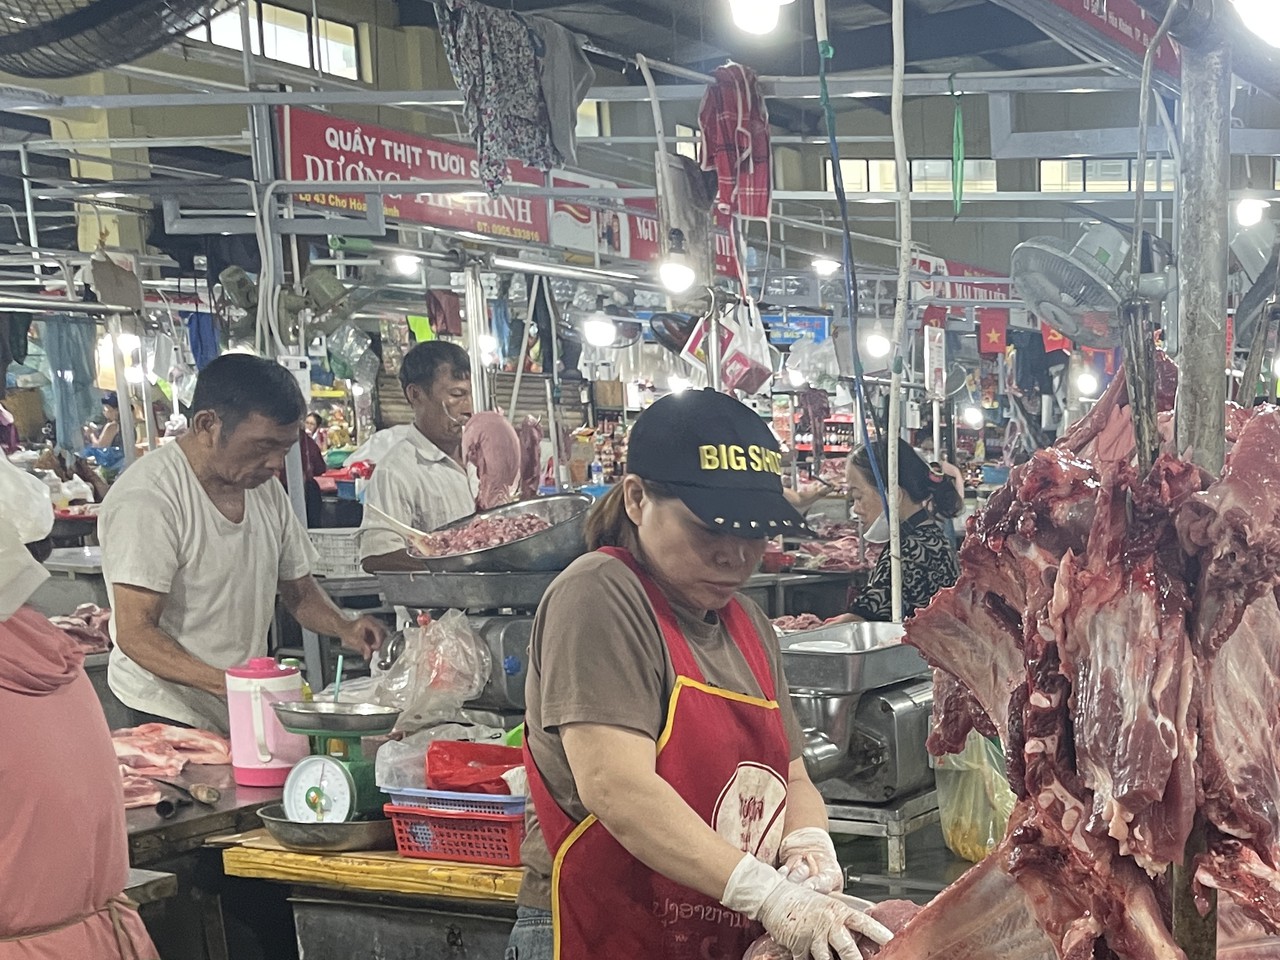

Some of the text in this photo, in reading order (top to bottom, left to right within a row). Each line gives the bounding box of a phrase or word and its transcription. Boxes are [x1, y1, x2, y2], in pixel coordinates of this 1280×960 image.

[325, 126, 376, 157] QUẦY
[381, 139, 422, 170] THỊT
[699, 444, 748, 471] BIG
